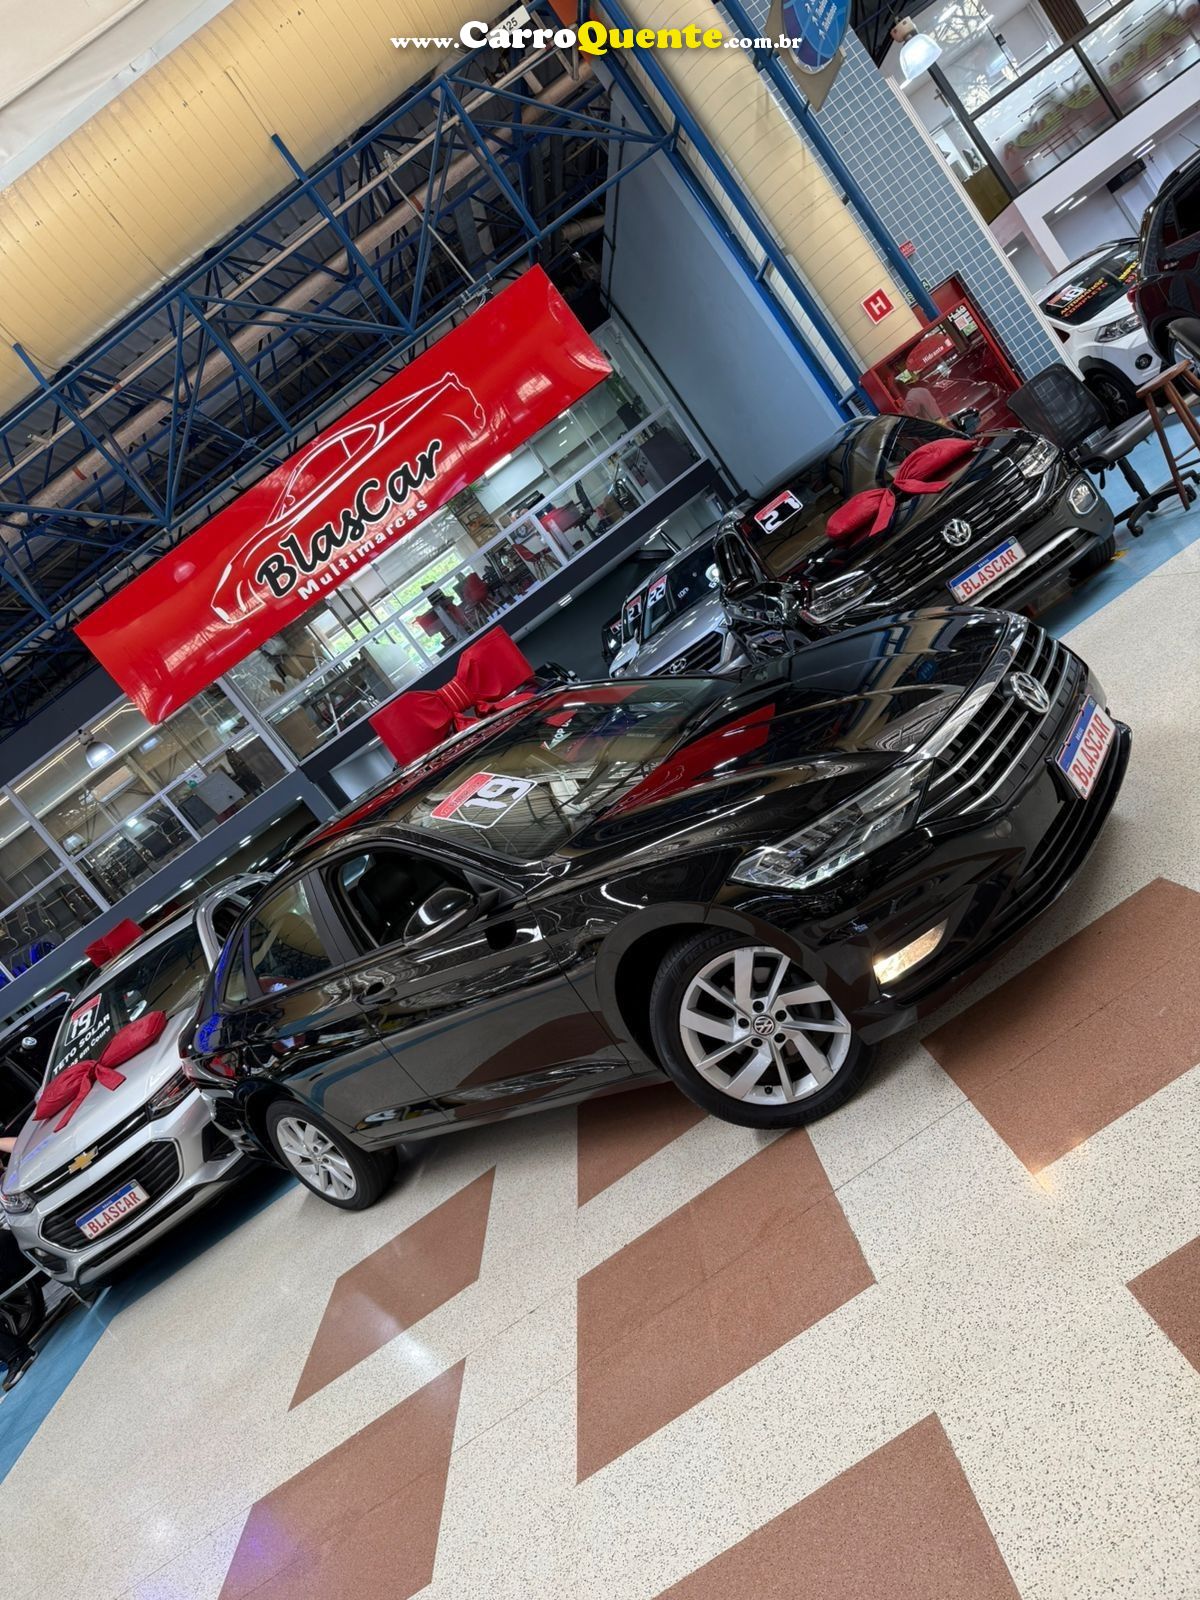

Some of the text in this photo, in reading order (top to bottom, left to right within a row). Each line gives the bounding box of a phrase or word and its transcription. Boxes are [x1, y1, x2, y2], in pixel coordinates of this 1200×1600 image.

[869, 296, 888, 316] H
[255, 438, 442, 598] BlasCar
[297, 500, 428, 600] Multimarcas
[961, 548, 1018, 596] BLASCAR
[1072, 713, 1111, 787] BLASCAR
[463, 777, 531, 810] 19
[53, 1013, 110, 1075] TETO SOLAR
[71, 1009, 93, 1039] 19
[91, 1026, 111, 1047] Couro
[87, 1191, 141, 1234] BLASCAR
